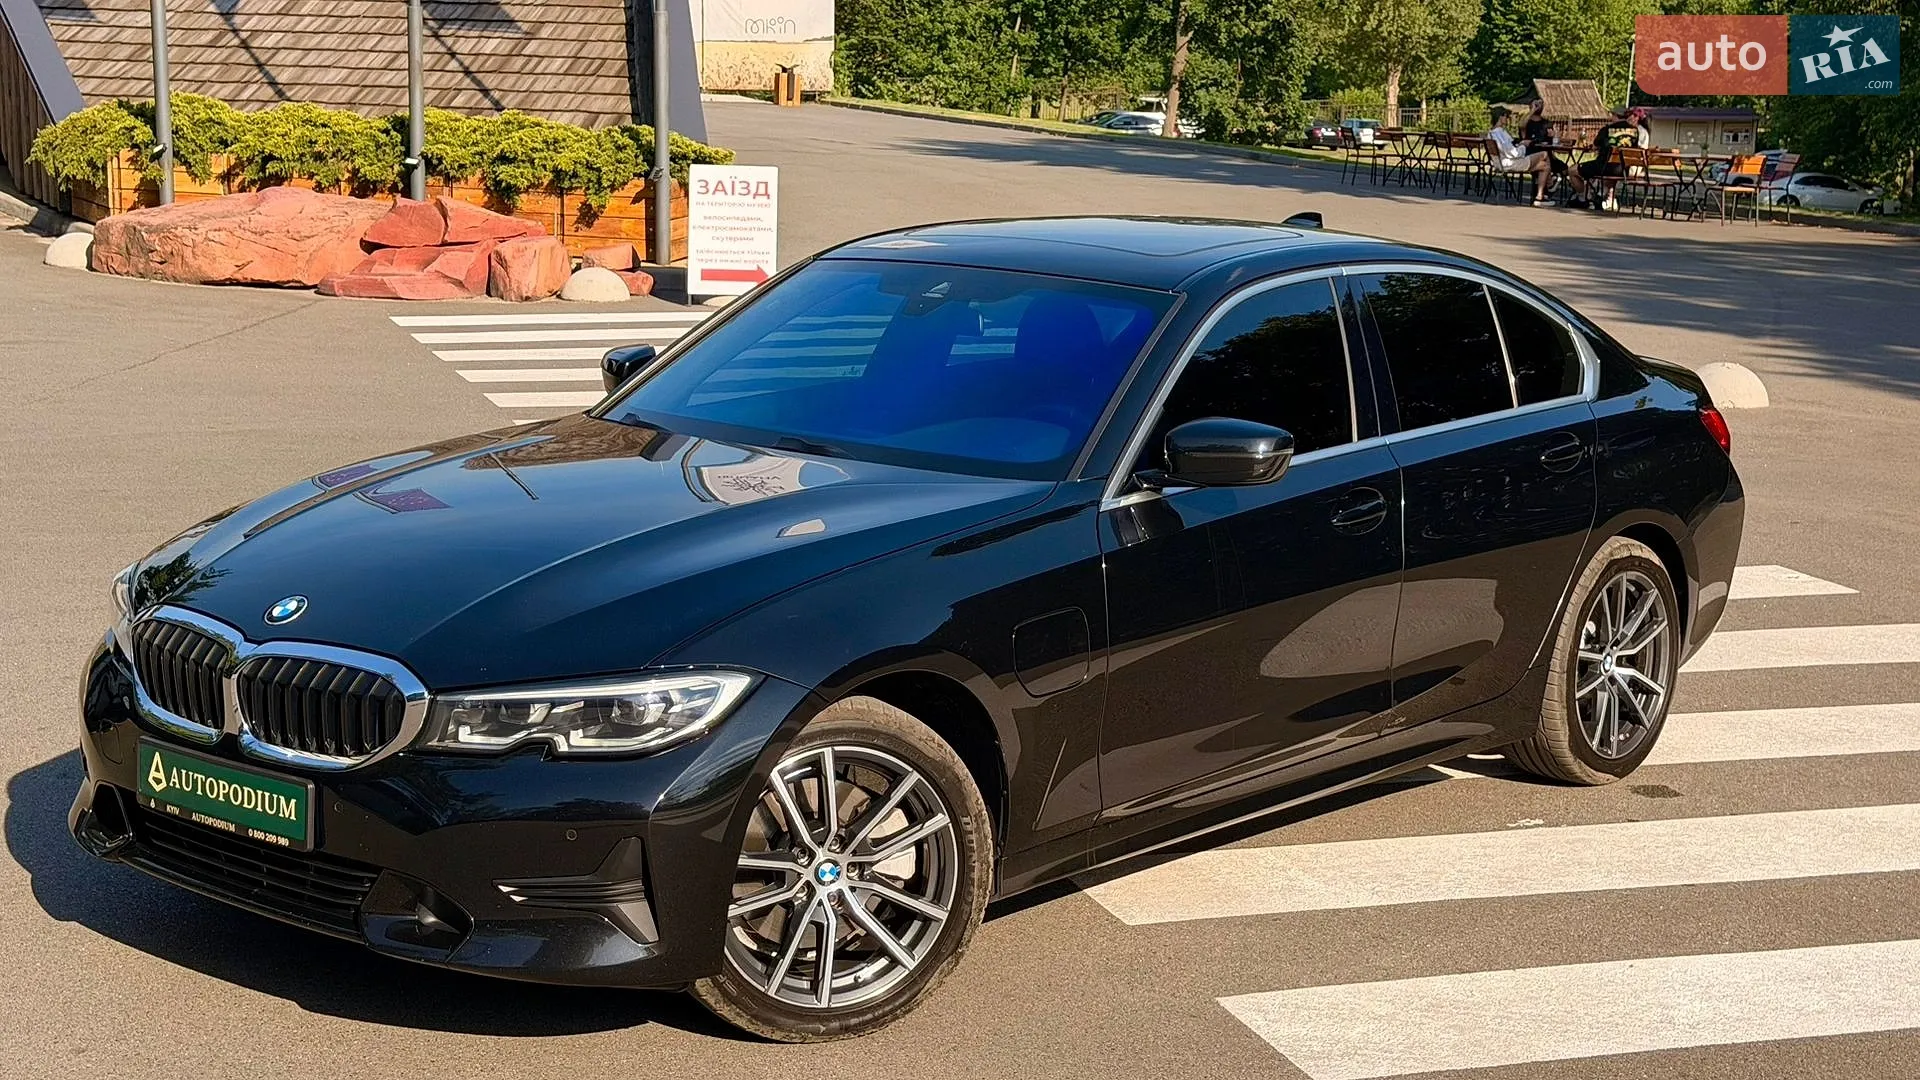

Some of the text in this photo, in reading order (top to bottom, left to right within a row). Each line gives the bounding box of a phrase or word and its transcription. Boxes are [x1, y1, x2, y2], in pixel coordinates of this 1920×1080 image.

[697, 175, 771, 200] ЗАЇЗД
[169, 767, 297, 821] AUTOPODIUM
[166, 804, 180, 816] KYIV
[191, 812, 235, 832] AUTOPODIUM
